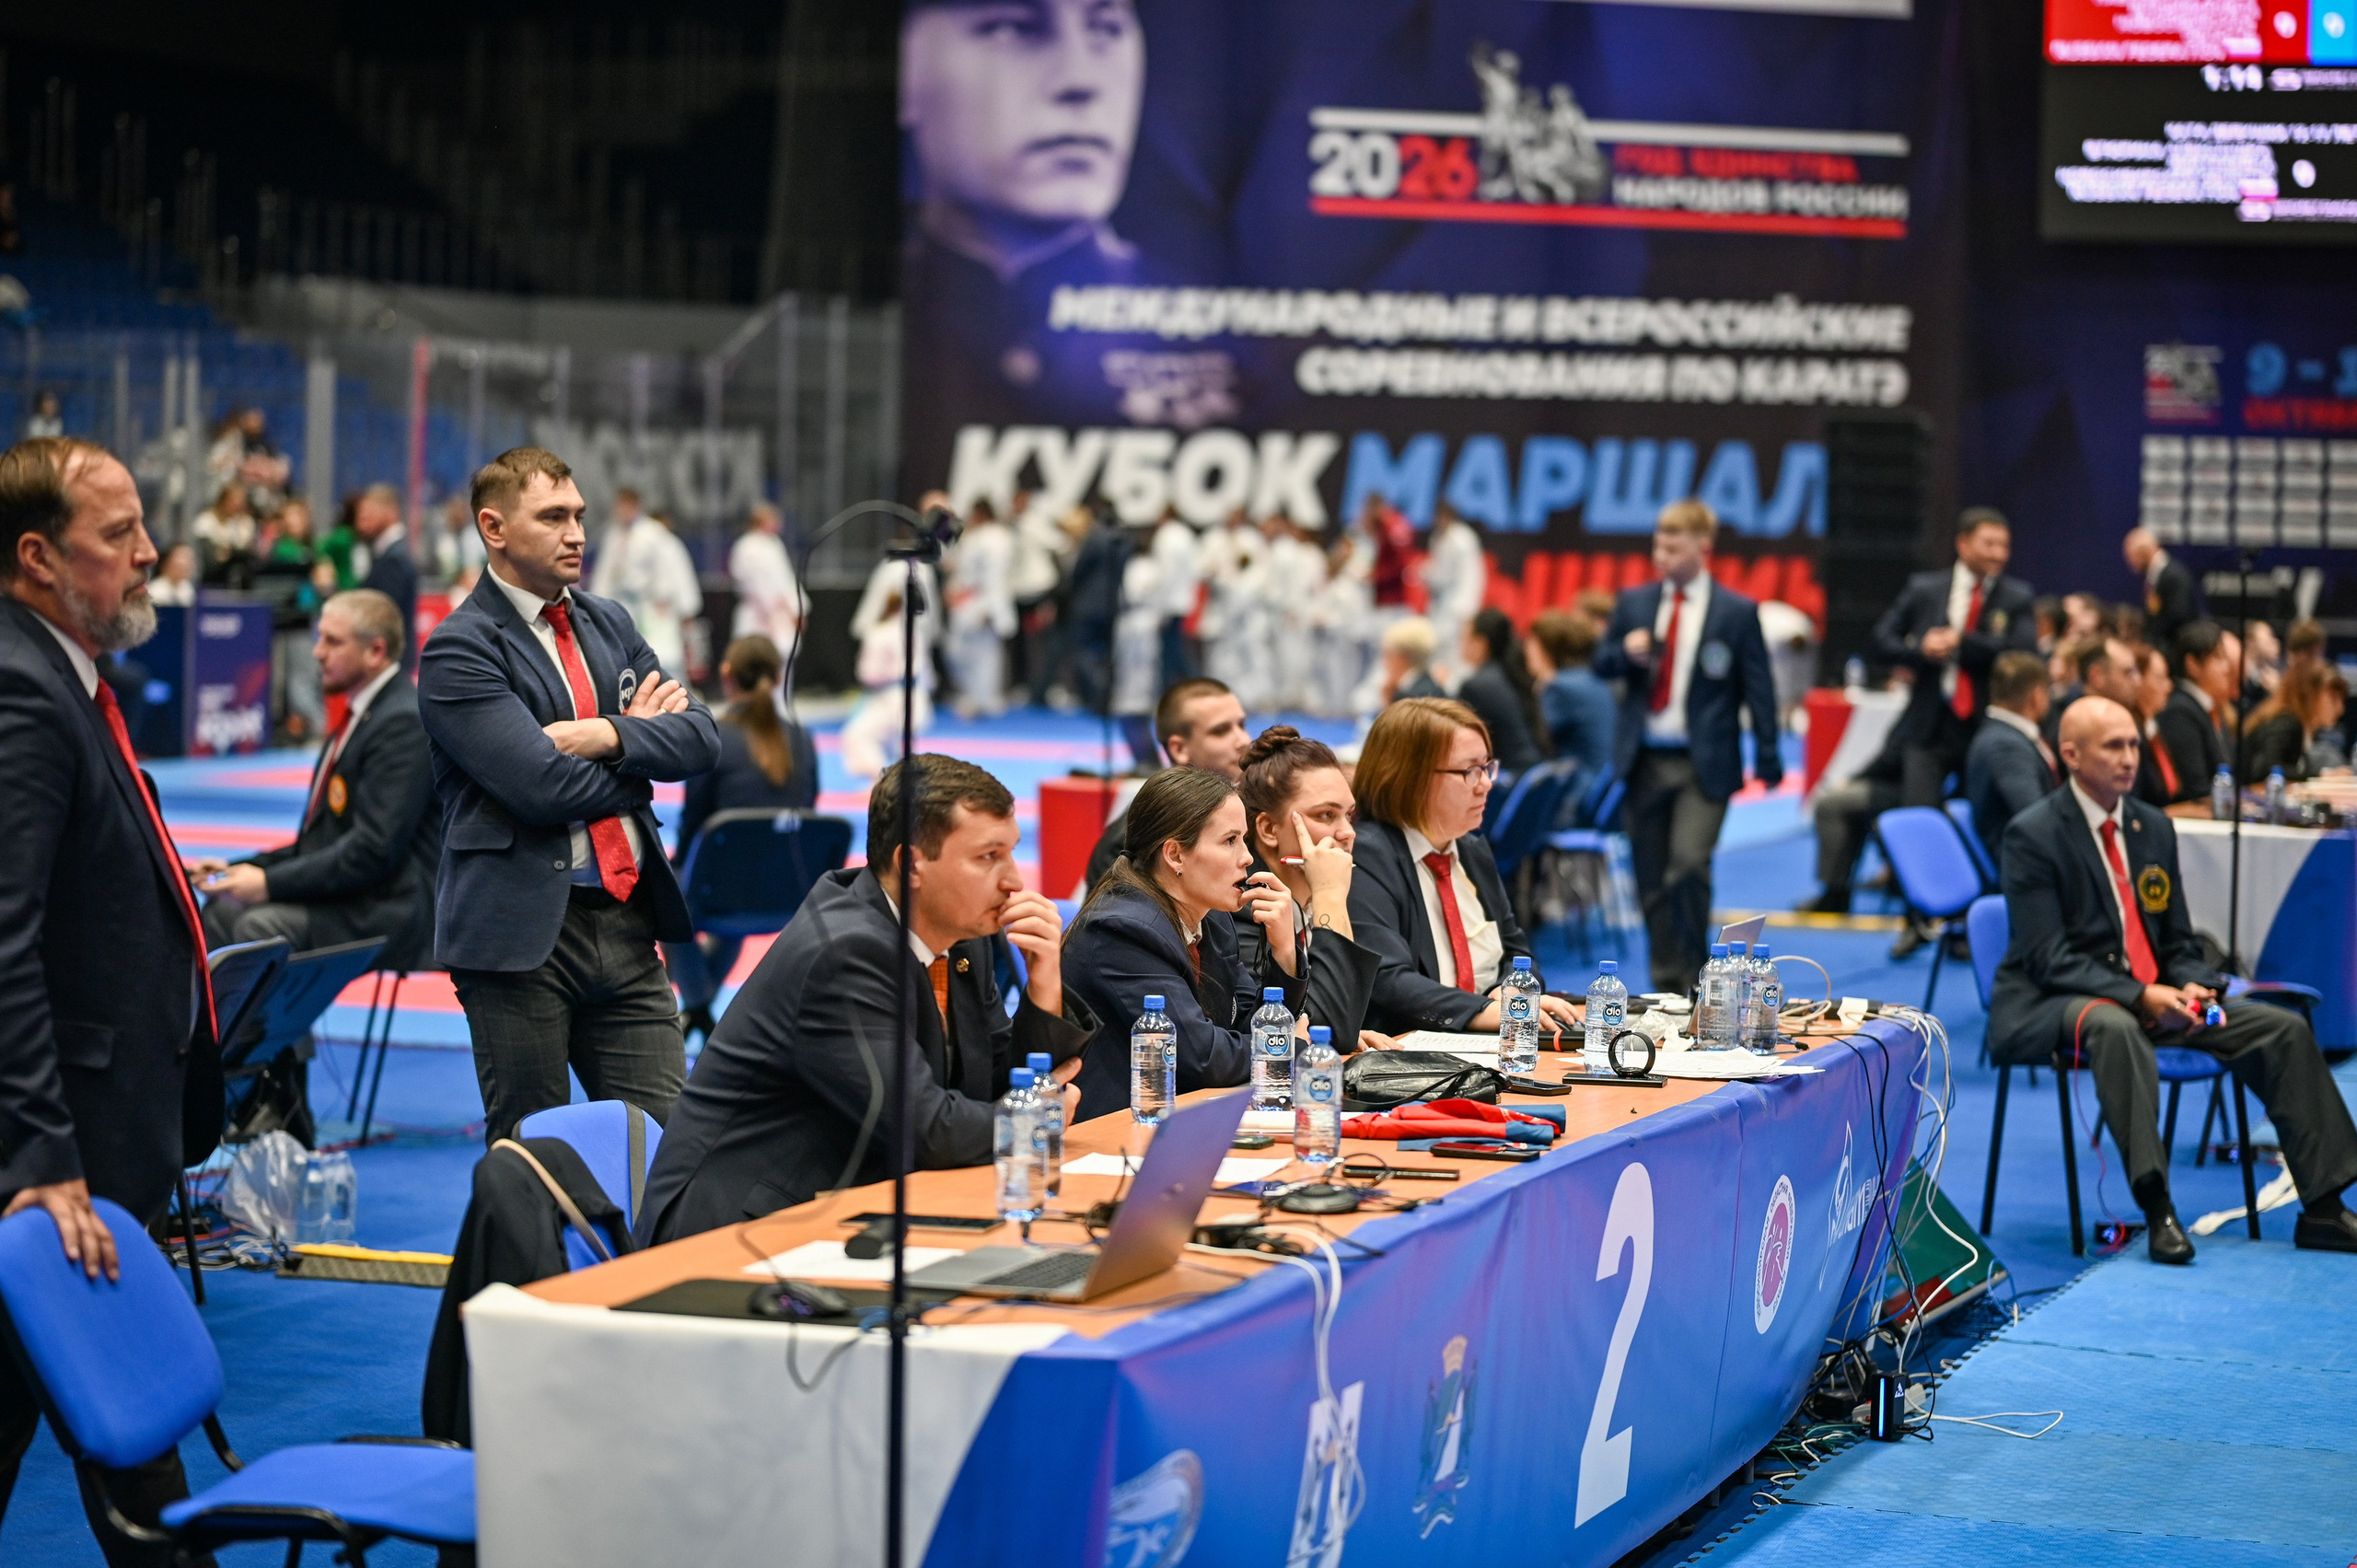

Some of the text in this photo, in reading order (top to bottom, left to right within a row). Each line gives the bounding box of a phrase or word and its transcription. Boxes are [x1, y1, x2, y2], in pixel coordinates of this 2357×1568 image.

[1308, 132, 1480, 201] 2026
[1612, 176, 1908, 222] НАРОДОВ РОССИИ
[1049, 285, 1912, 354] МЕЖДУНАРОДНЫЕ И ВСЕРОССИЙСКИЕ
[1295, 346, 1665, 402] СОРЕВНОВАНИЯ
[1670, 353, 1736, 404] ПО
[1741, 356, 1910, 408] КАРАТЭ
[948, 424, 1341, 530] КУБОК
[1574, 1162, 1655, 1528] 2
